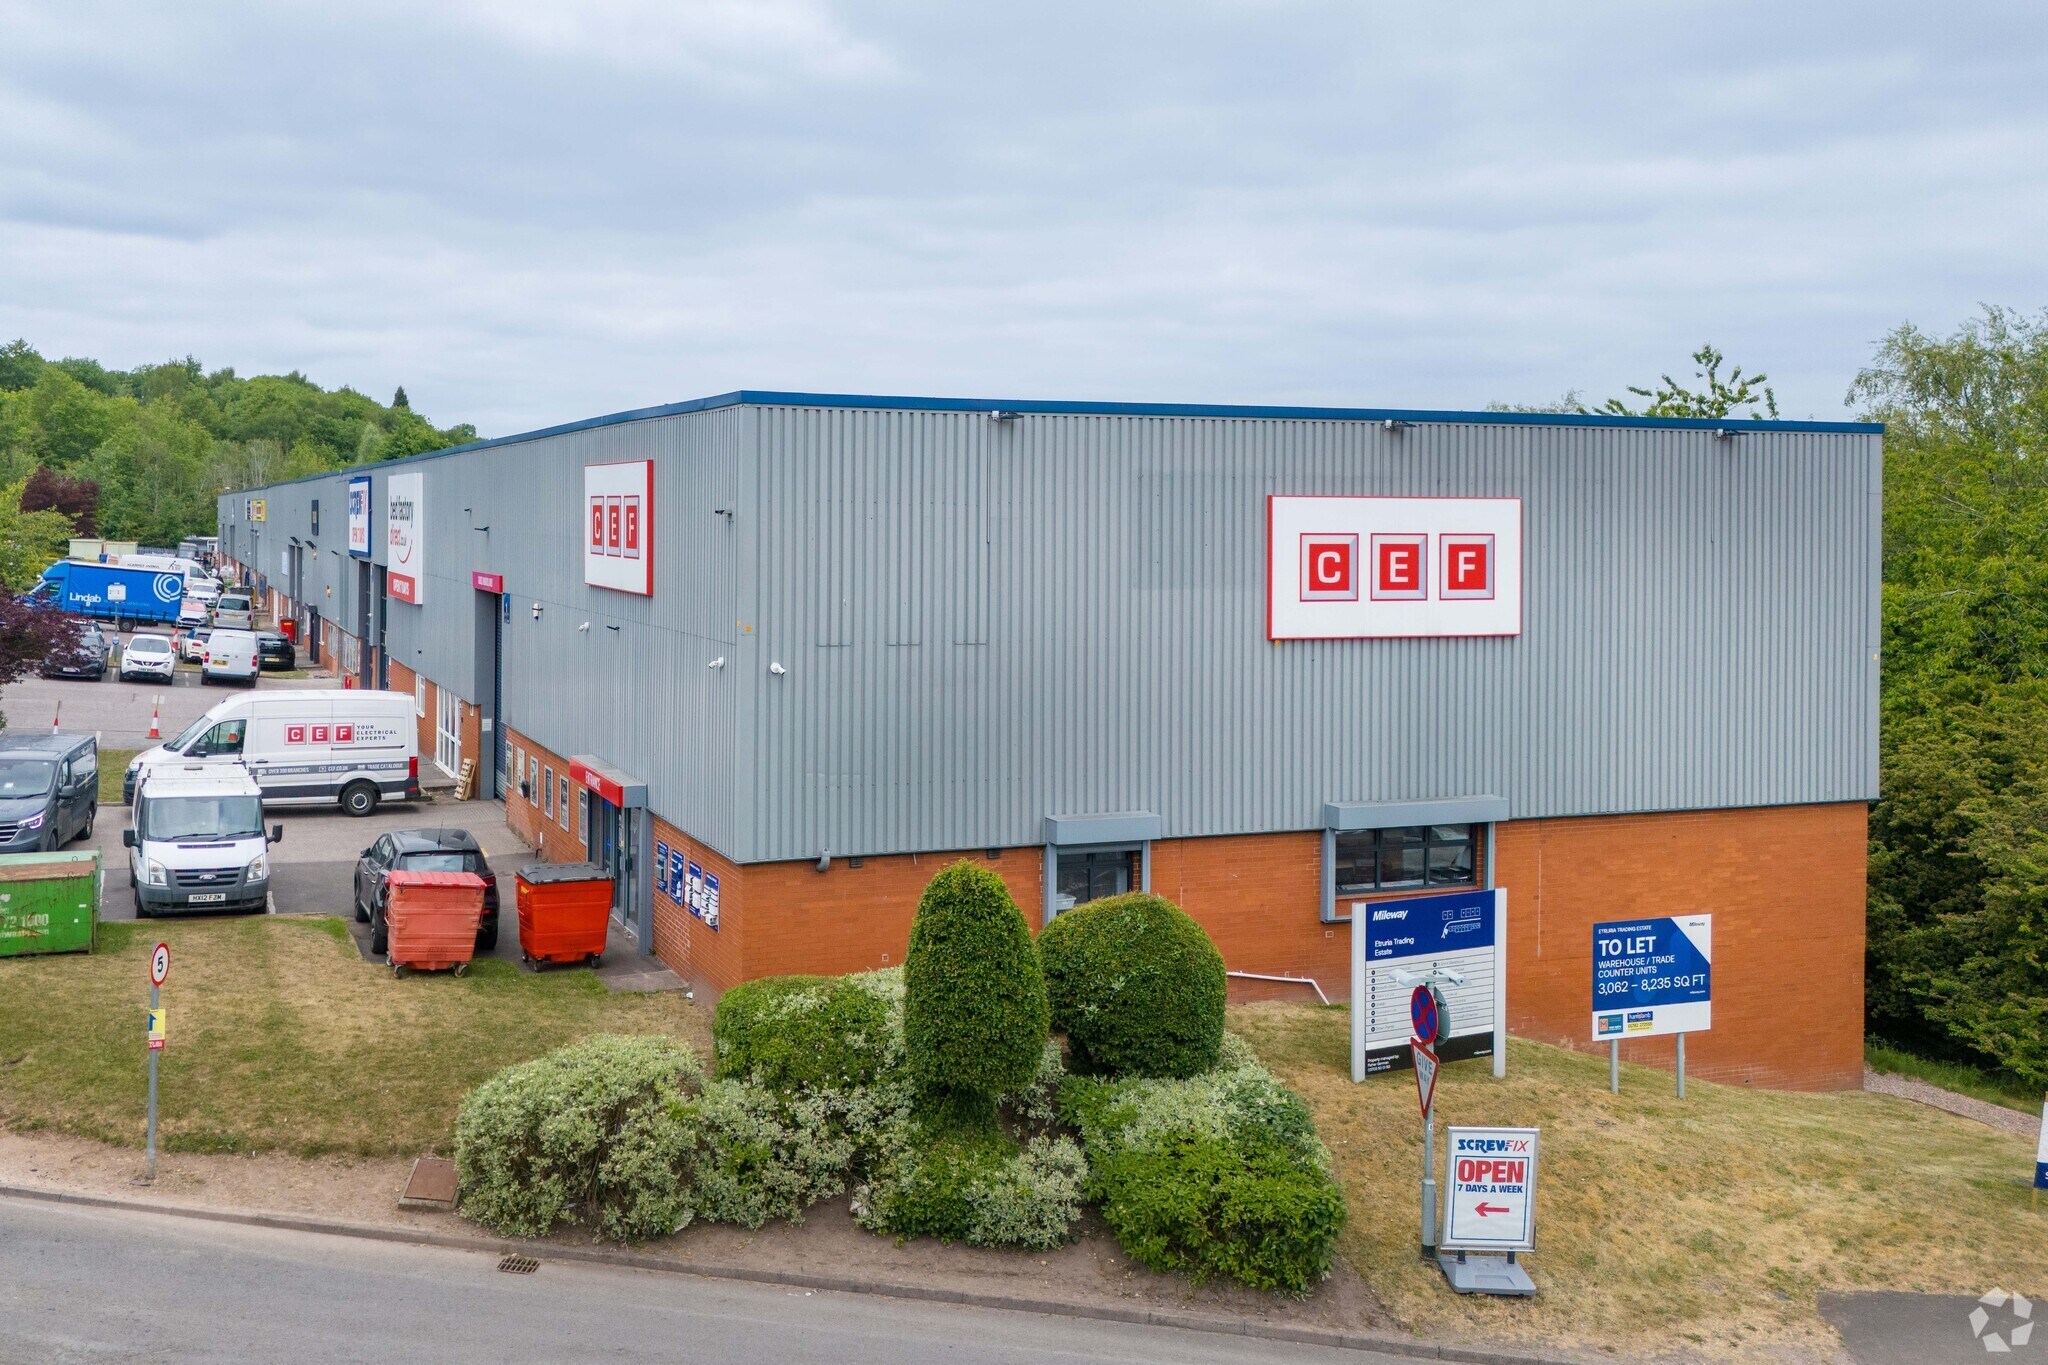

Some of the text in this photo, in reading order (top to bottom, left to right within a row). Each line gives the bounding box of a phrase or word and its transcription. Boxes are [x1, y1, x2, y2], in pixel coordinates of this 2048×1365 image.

[594, 512, 635, 542] CEF
[1317, 551, 1477, 583] CEF
[69, 592, 102, 603] Lindab
[290, 728, 348, 740] CEF
[1372, 910, 1408, 921] Mileway
[1374, 936, 1414, 948] Etruria Trading
[1598, 936, 1656, 956] TO LET
[1374, 948, 1392, 956] Estate
[158, 956, 164, 973] 5
[1598, 958, 1645, 969] WAREHOUSE
[1652, 954, 1675, 964] TRADE
[1598, 966, 1658, 978] COUNTER UNITS
[1598, 980, 1628, 996] 3,062
[1641, 977, 1671, 992] 8,235
[1674, 976, 1690, 988] SQ
[1692, 974, 1706, 986] FT
[1416, 1052, 1433, 1076] GIVE
[1419, 1070, 1430, 1086] WAY
[1458, 1138, 1530, 1154] SCREWFIX
[1458, 1159, 1524, 1184] OPEN
[1458, 1184, 1524, 1194] 7 DAYS A WEEK
